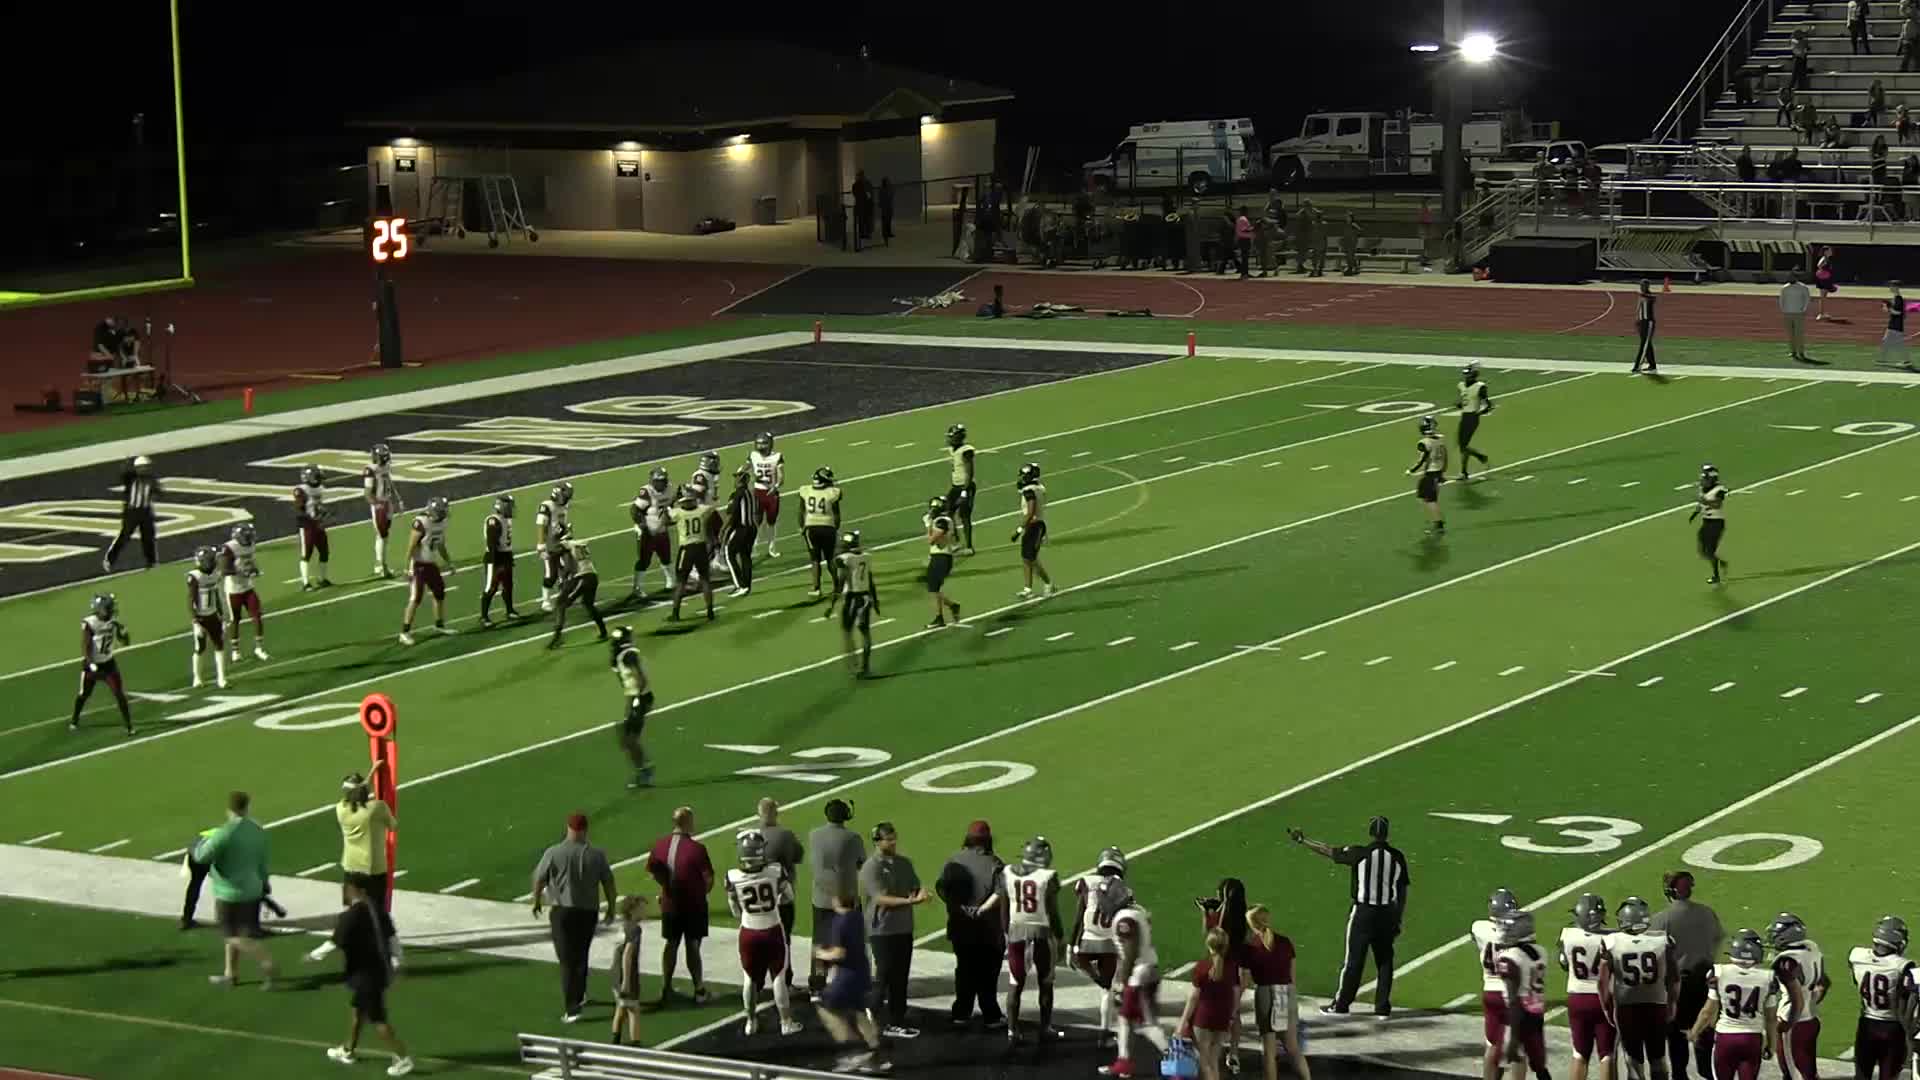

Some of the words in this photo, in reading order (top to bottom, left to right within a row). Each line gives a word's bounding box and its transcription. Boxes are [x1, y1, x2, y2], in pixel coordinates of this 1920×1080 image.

[373, 218, 407, 260] 25
[808, 496, 826, 514] 94
[685, 518, 701, 536] 10
[733, 746, 1037, 793] 20
[1500, 815, 1824, 871] 30
[742, 883, 776, 913] 29
[1014, 879, 1037, 913] 18
[1621, 951, 1658, 986] 59
[1725, 983, 1760, 1019] 34
[1860, 970, 1889, 1010] 48
